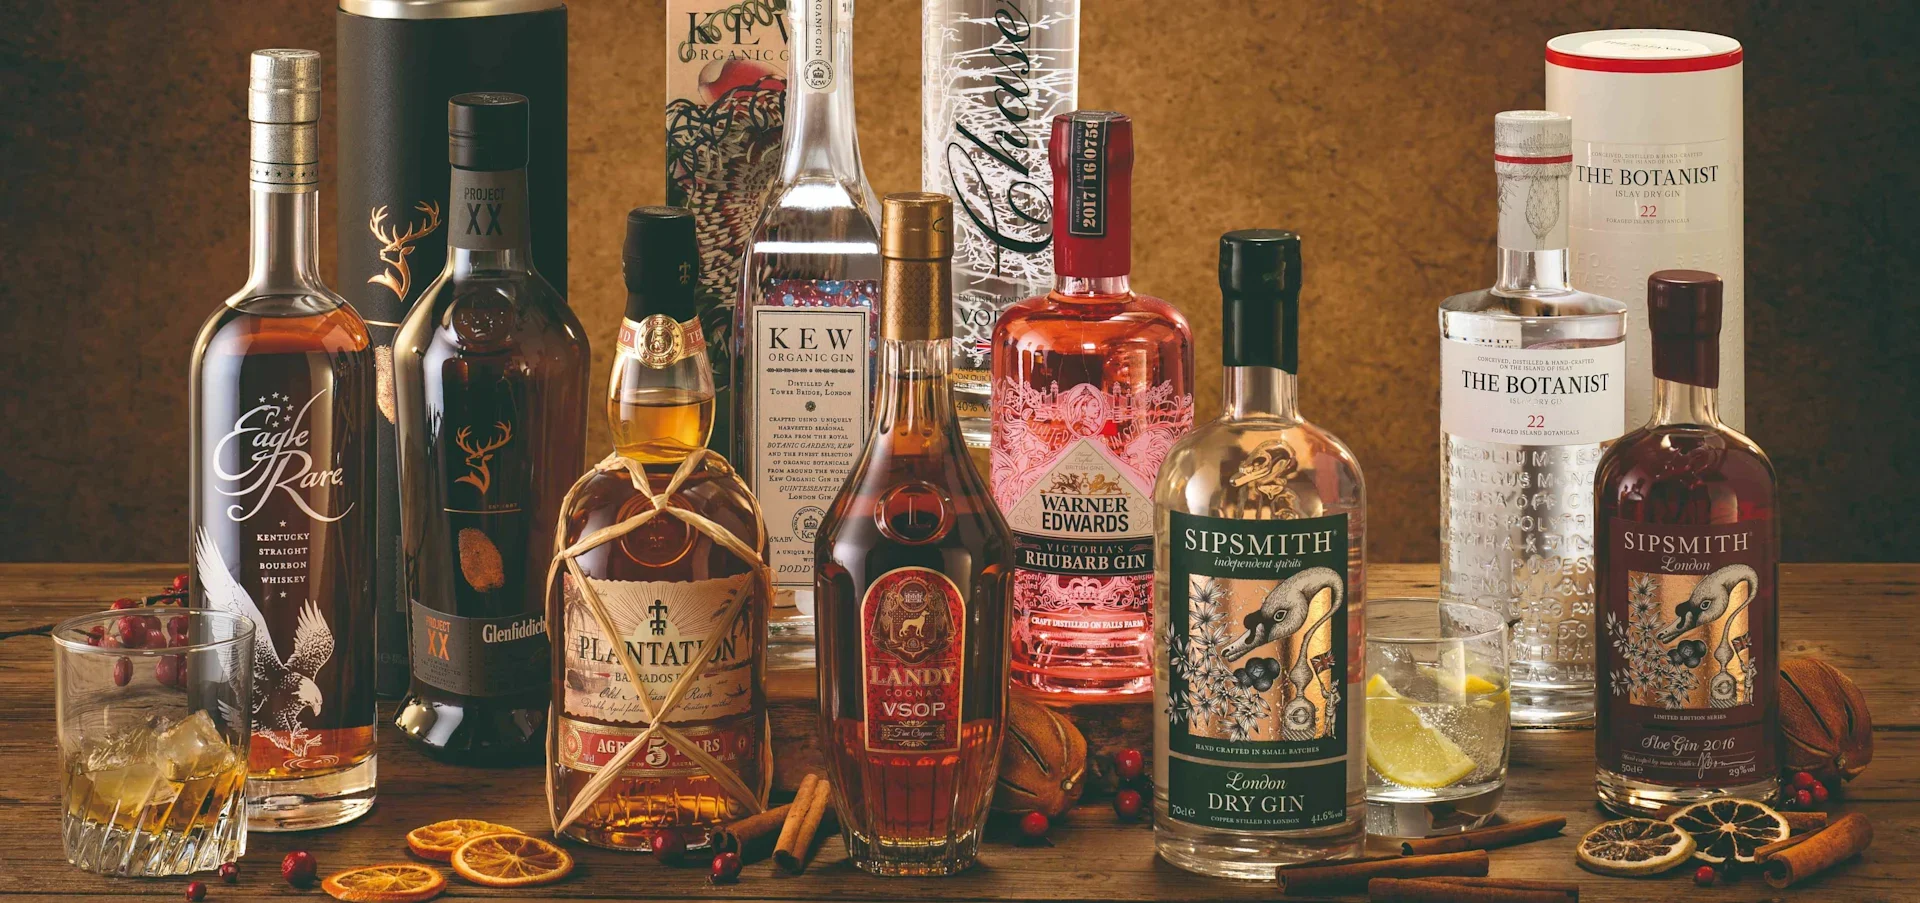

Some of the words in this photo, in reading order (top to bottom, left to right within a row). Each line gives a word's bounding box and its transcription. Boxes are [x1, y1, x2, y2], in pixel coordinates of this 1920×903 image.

[686, 49, 774, 61] ORGANIC
[947, 0, 1053, 277] Chase
[1083, 163, 1097, 180] 16
[1576, 164, 1613, 185] THE
[1620, 165, 1719, 186] BOTANIST
[464, 187, 506, 200] PROJECT
[1616, 190, 1640, 198] ISLAY
[1083, 191, 1096, 228] 2017
[1640, 205, 1657, 217] 22
[466, 203, 503, 235] XX
[769, 327, 853, 350] KEW
[769, 353, 827, 362] ORGANIC
[831, 354, 853, 362] GIN
[1477, 356, 1511, 364] CONCEIVED,
[1462, 370, 1499, 392] THE
[1506, 373, 1609, 394] BOTANIST
[1527, 415, 1545, 428] 22
[213, 388, 327, 496] Eagle
[1032, 422, 1069, 447] UNITED
[1040, 494, 1129, 513] WARNER
[1042, 512, 1129, 533] EDWARDS
[257, 533, 310, 541] KENTUCKY
[1185, 528, 1332, 556] SIPSMITH
[1624, 531, 1748, 554] SIPSMITH
[259, 547, 308, 555] STRAIGHT
[1046, 543, 1124, 554] VICTORIA'S
[260, 561, 307, 570] BOURBON
[1025, 550, 1109, 570] RHUBARB
[1114, 554, 1146, 570] GIN
[1214, 556, 1271, 571] independent
[1274, 558, 1302, 572] spirits
[1661, 556, 1711, 572] London
[261, 576, 306, 584] WHISKEY
[425, 616, 450, 633] PROJECT
[482, 616, 546, 643] Glenfiddich
[1031, 617, 1052, 626] CRAFT
[1053, 619, 1089, 628] DISTILLED
[1090, 620, 1100, 628] ON
[1103, 620, 1123, 628] FALLS
[1124, 619, 1144, 628] FARM
[428, 630, 449, 661] XX
[615, 672, 672, 683] BABADOS
[870, 666, 955, 686] LANDY
[599, 686, 619, 700] Old
[685, 687, 714, 700] Rum
[885, 689, 943, 697] COGNAC
[882, 702, 945, 717] VSOP
[891, 729, 911, 739] Fine
[911, 728, 934, 738] Cognac
[597, 738, 628, 754] AGE
[645, 738, 670, 768] 5
[1195, 744, 1214, 752] HAND
[1216, 747, 1249, 755] CRAFTED
[1289, 746, 1320, 754] BATCHES
[1641, 735, 1671, 751] Sloe
[1671, 735, 1699, 756] Gin
[1703, 737, 1735, 751] 2016
[1226, 771, 1287, 790] London
[1208, 792, 1255, 812] DRY
[1261, 795, 1305, 813] GIN
